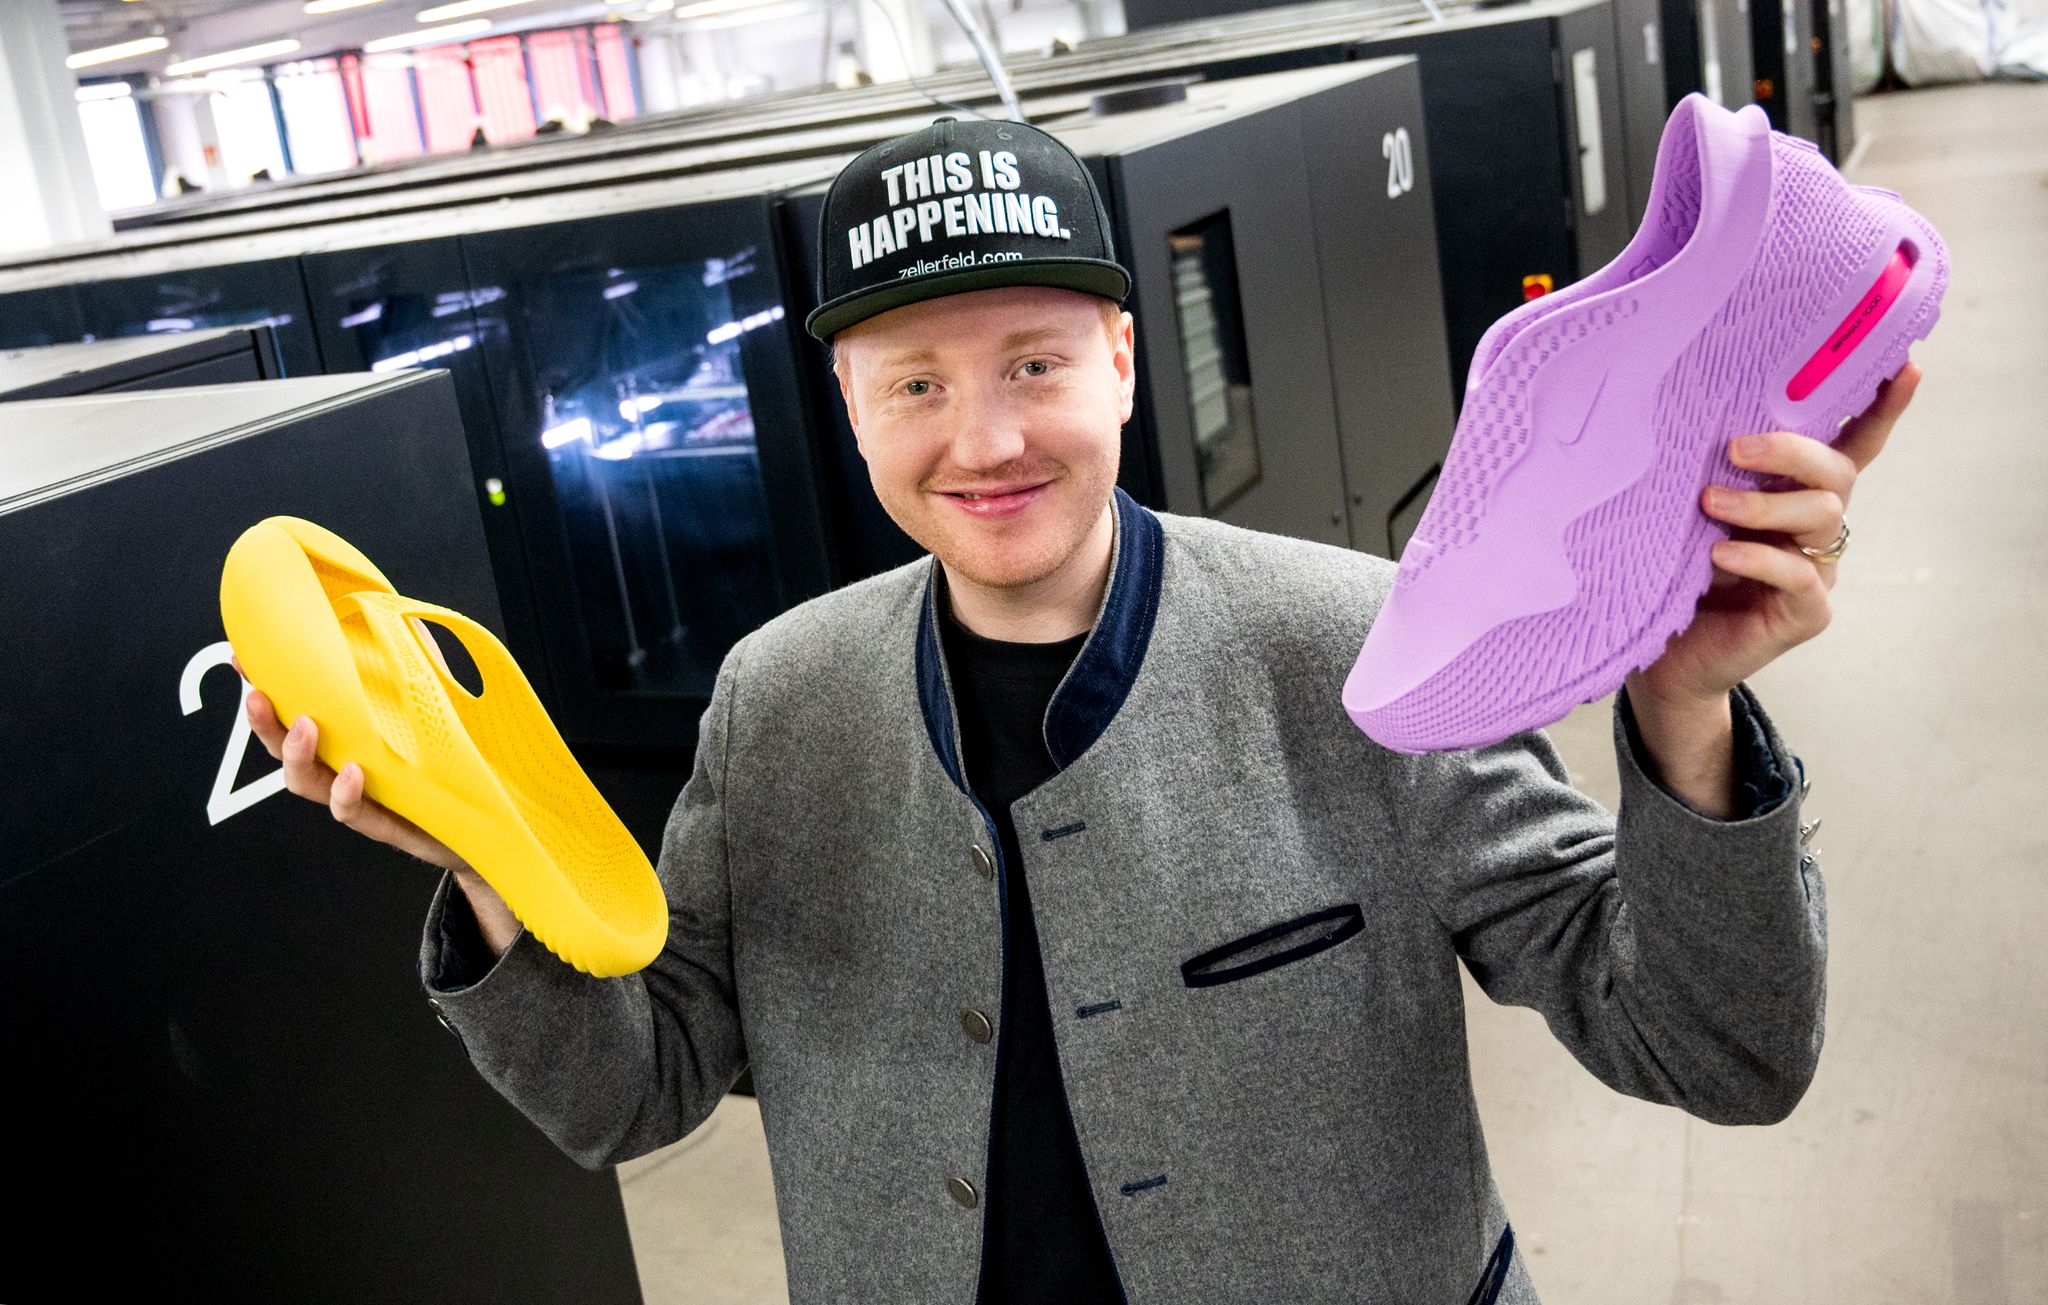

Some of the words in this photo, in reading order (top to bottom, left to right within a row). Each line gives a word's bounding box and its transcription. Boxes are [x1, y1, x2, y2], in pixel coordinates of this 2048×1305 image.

[881, 152, 973, 206] THIS
[979, 150, 1020, 190] IS
[1382, 127, 1413, 198] 20
[848, 192, 1071, 270] HAPPENING.
[899, 251, 1022, 279] zellerfeld.com
[179, 641, 288, 826] 2
